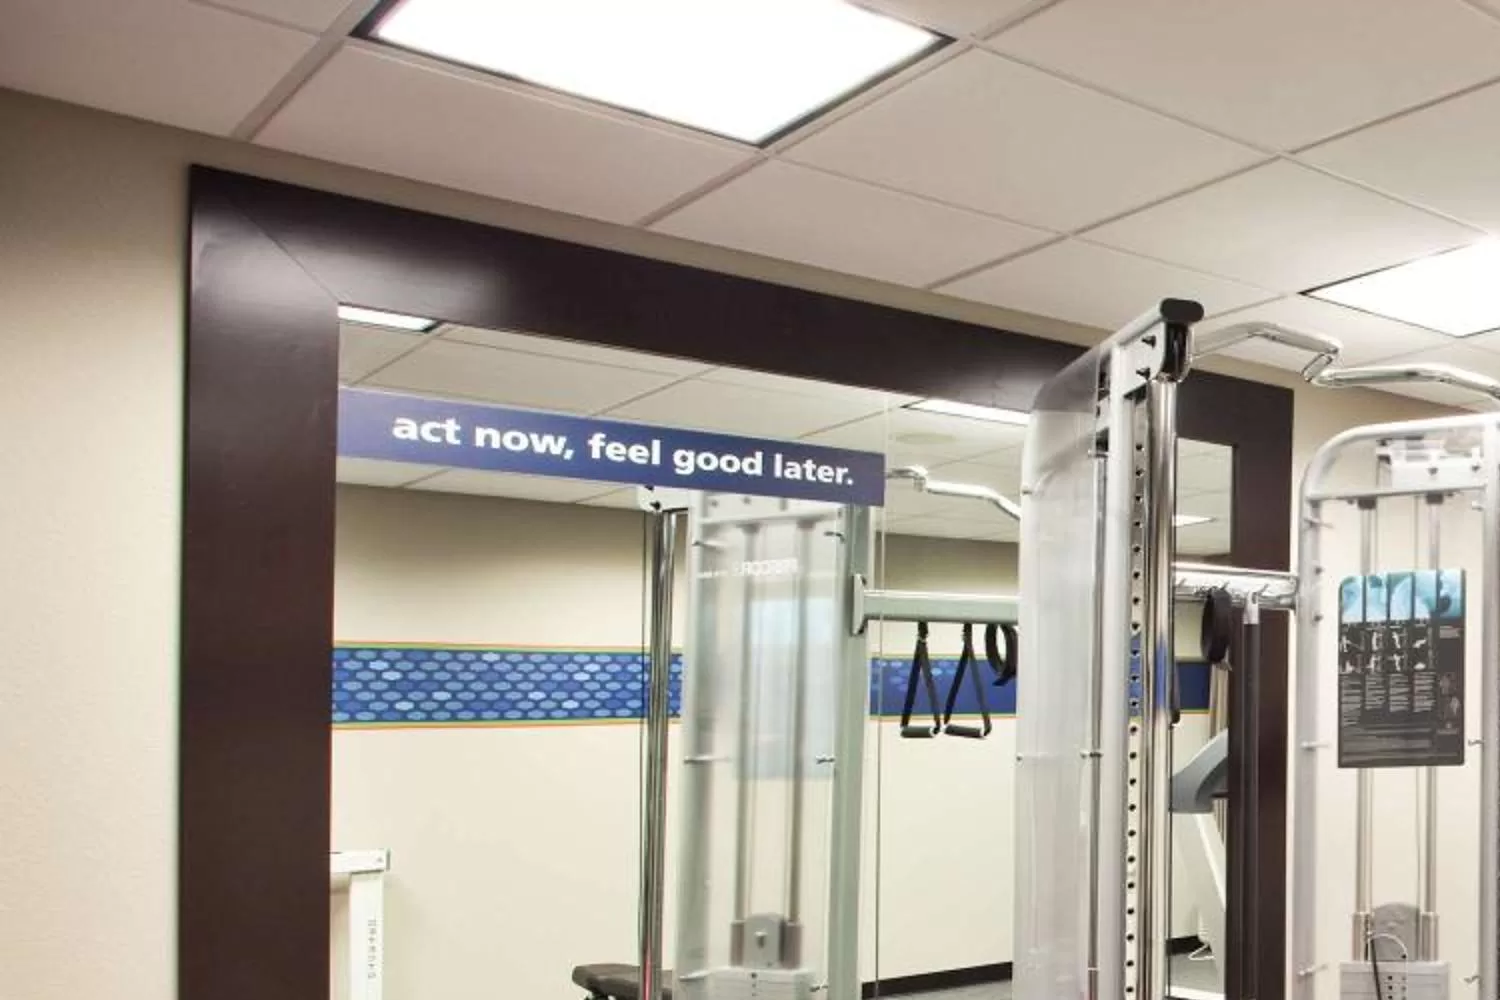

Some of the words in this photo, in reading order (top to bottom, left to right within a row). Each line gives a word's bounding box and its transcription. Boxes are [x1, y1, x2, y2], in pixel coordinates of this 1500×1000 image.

[391, 416, 461, 445] act
[475, 426, 573, 460] now,
[588, 433, 661, 465] feel
[673, 450, 762, 476] good
[775, 453, 854, 485] later.
